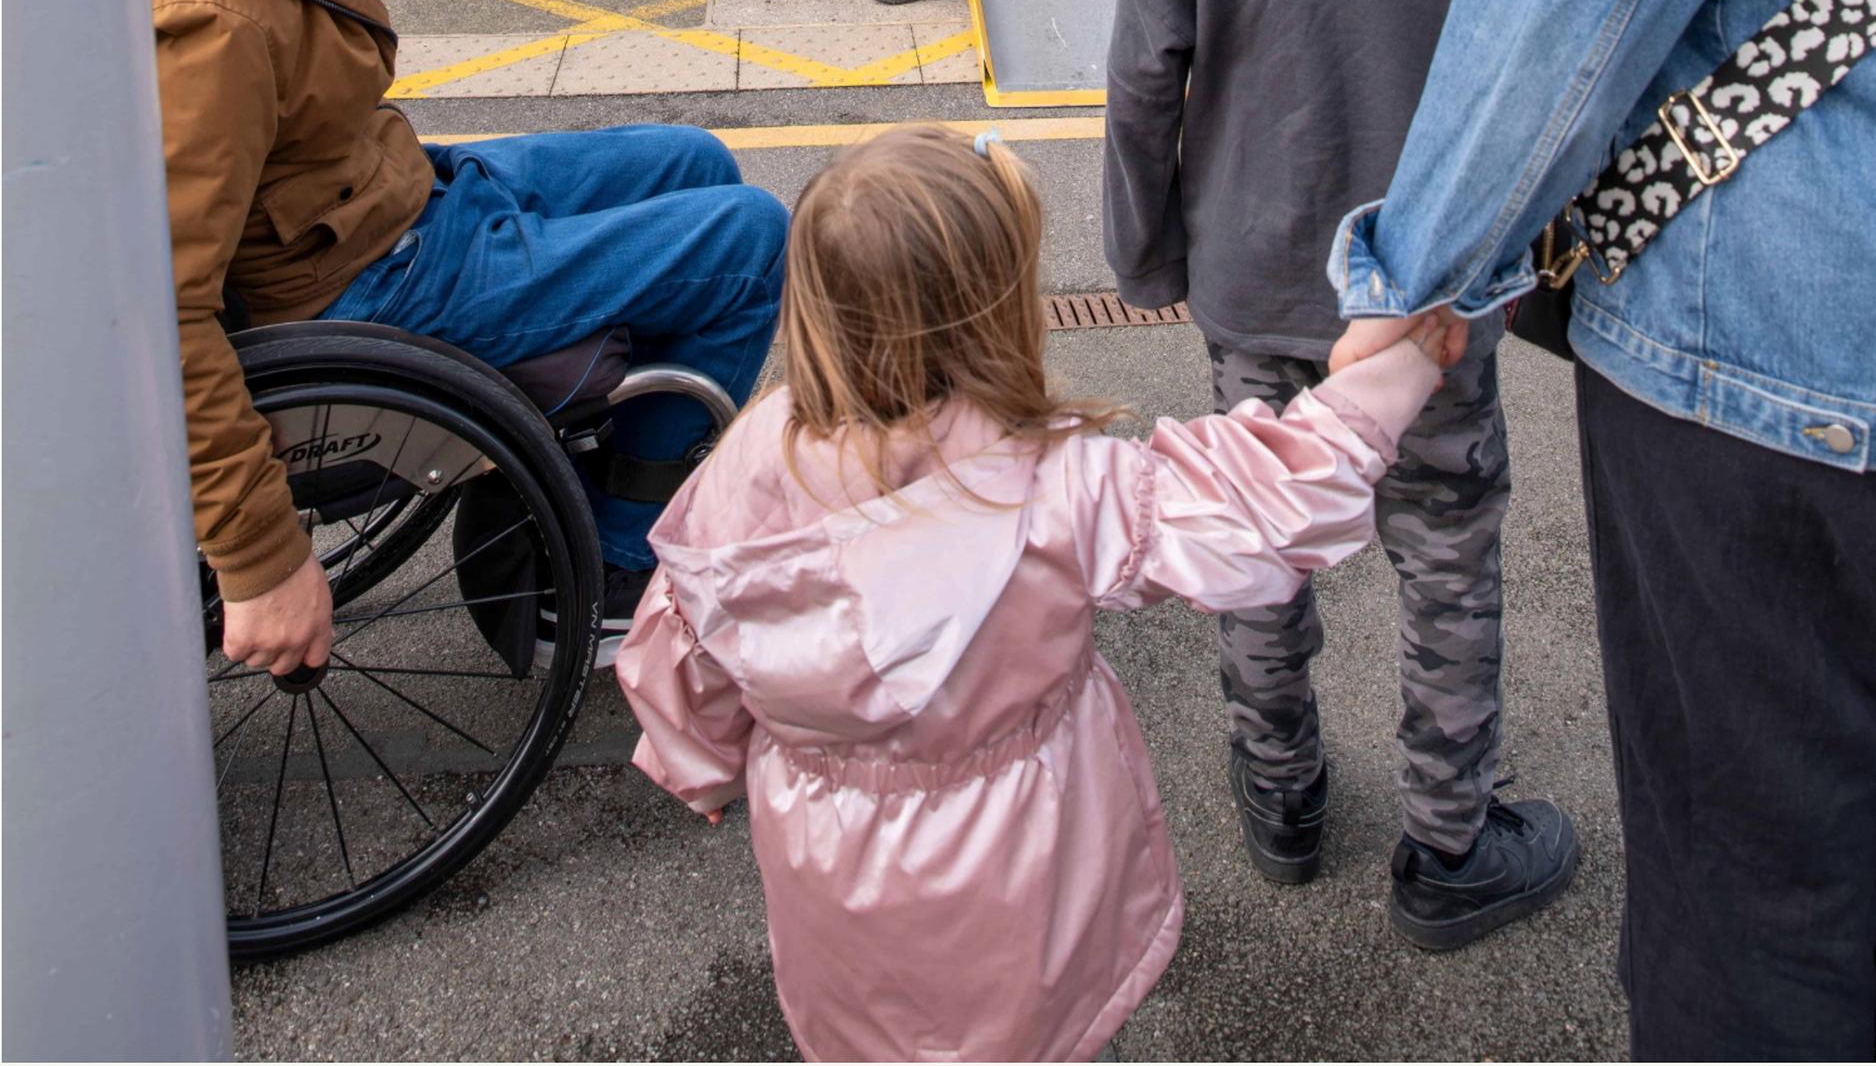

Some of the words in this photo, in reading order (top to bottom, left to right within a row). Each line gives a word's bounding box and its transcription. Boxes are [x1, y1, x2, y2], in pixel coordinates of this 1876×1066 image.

[289, 433, 371, 464] DRAFT
[590, 601, 599, 629] VN
[567, 633, 596, 718] MASTER
